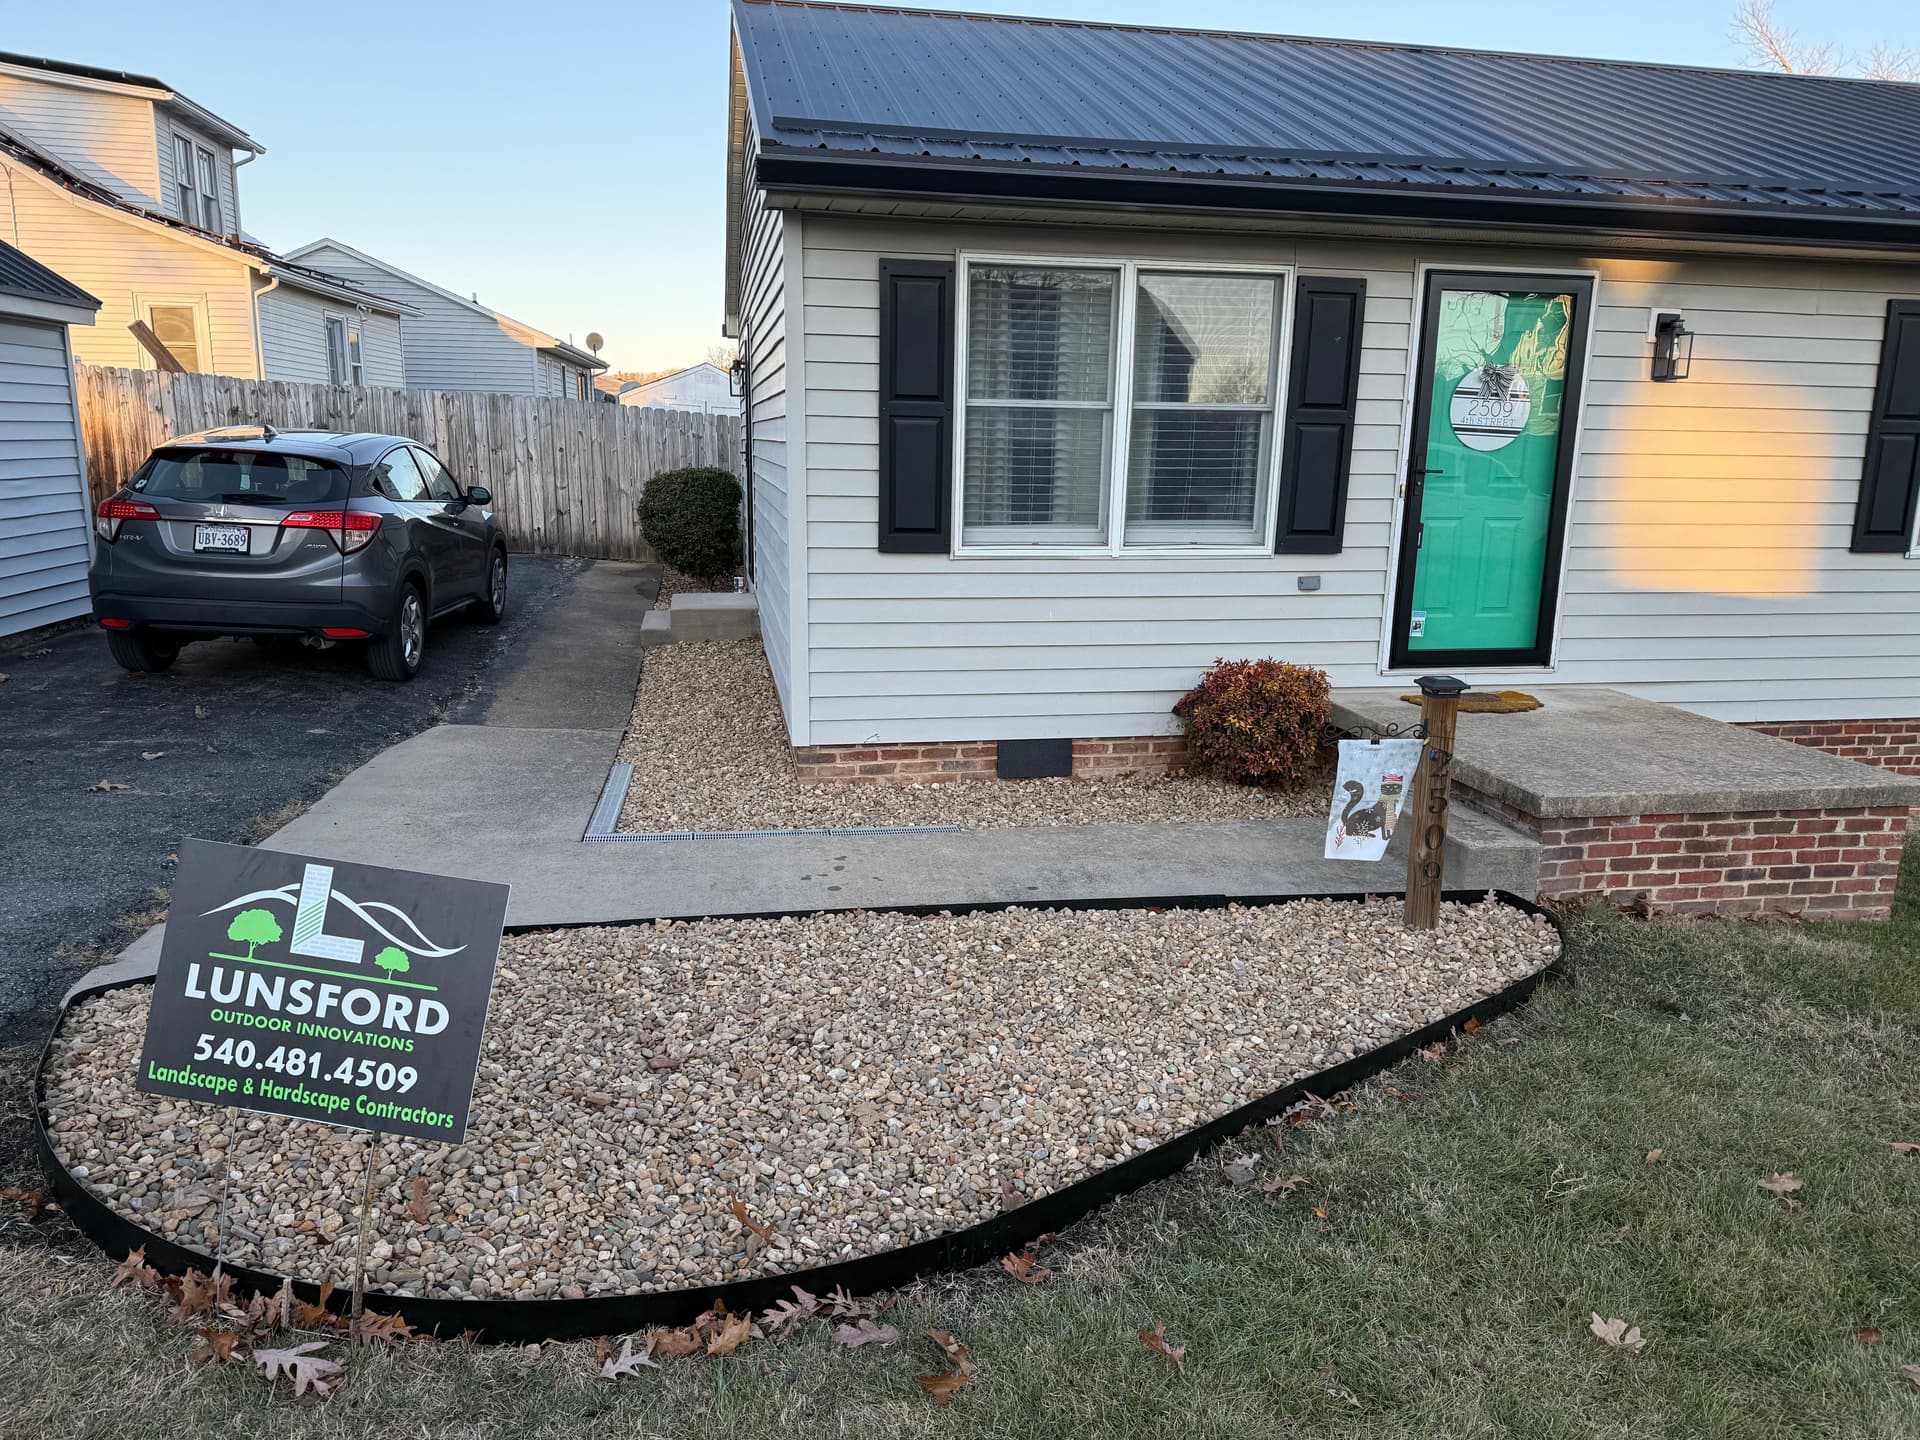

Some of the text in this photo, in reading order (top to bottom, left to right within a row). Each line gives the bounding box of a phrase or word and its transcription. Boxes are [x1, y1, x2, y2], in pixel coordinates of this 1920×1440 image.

[1467, 399, 1513, 418] 2509
[1476, 416, 1514, 427] STREET
[198, 532, 247, 547] UBY-3689
[184, 962, 450, 1036] LUNSFORD
[210, 1008, 415, 1053] OUTDOOR INNOVATIONS
[193, 1033, 418, 1094] 540.481.4509
[147, 1060, 455, 1129] Landscape & Hardscape Contractors
